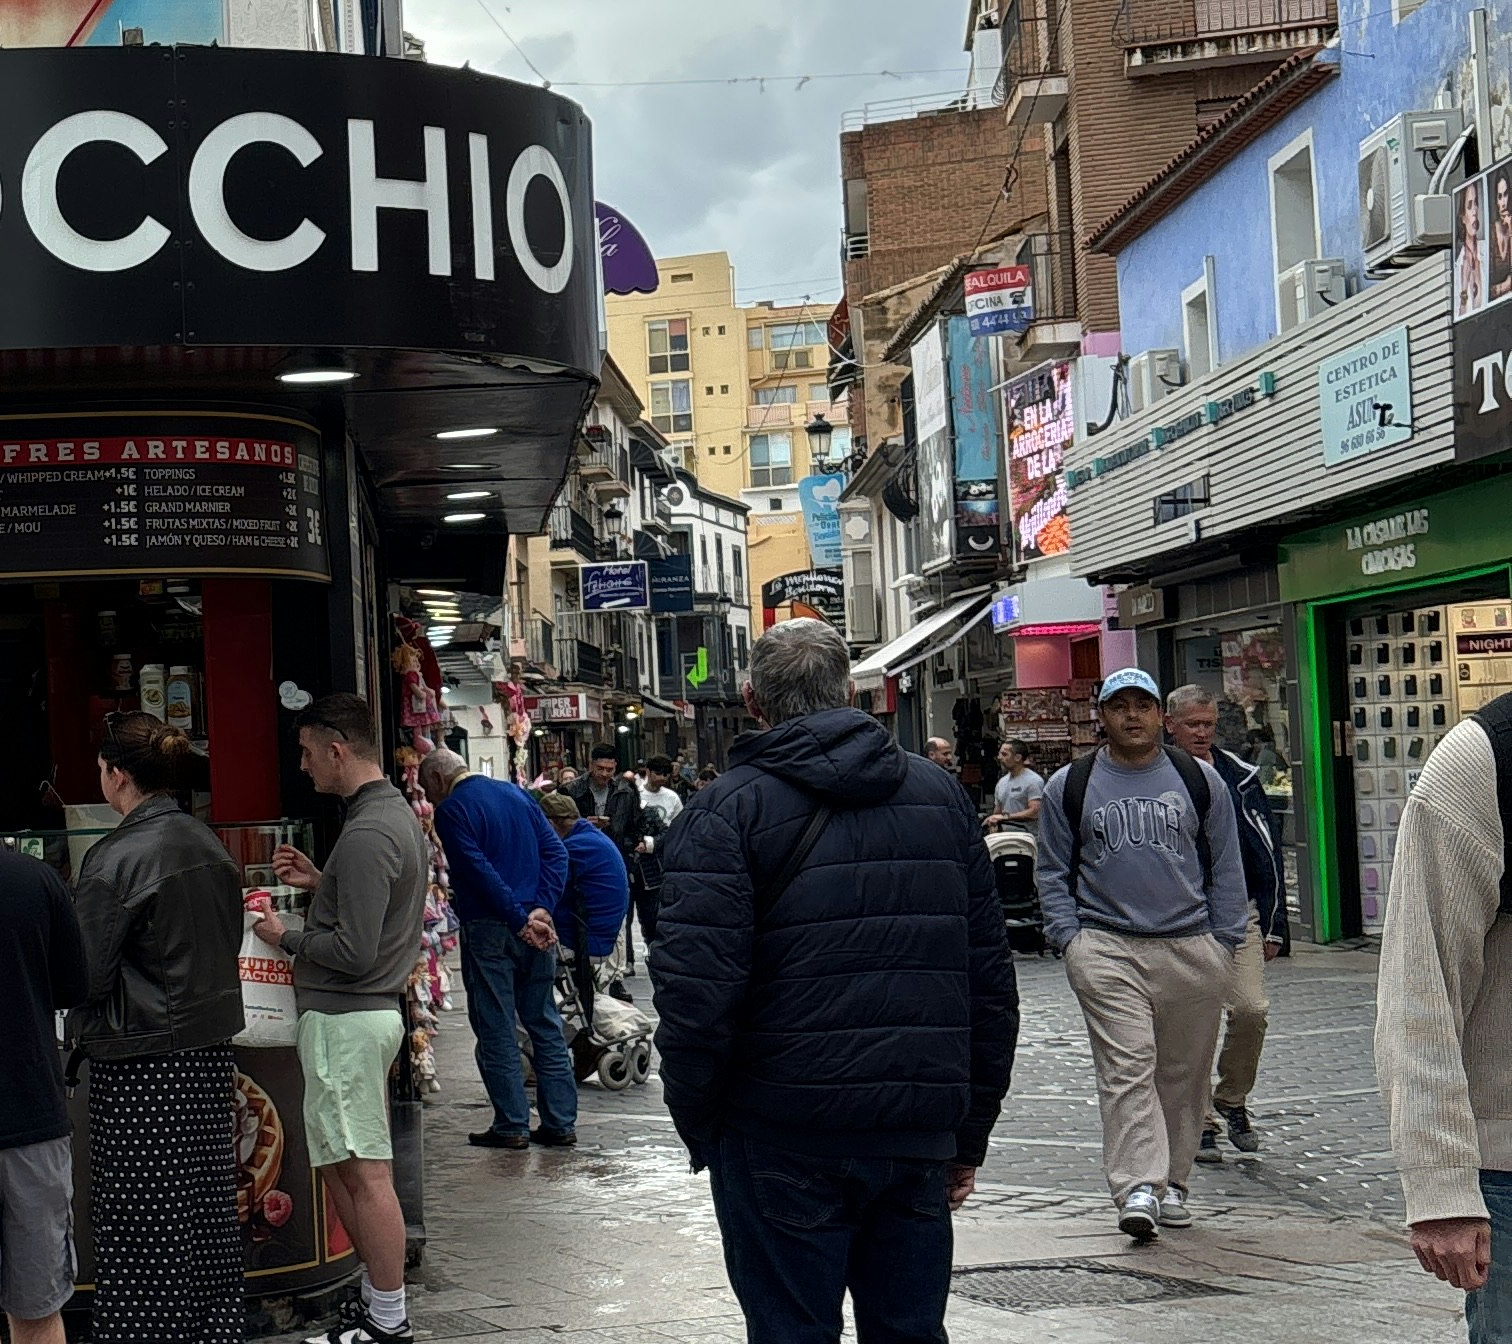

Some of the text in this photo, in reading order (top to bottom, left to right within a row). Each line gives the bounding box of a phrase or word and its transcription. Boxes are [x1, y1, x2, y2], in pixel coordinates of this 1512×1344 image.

[1326, 340, 1400, 385] CENTRO DE
[1334, 366, 1398, 404] ESTETICA
[120, 440, 294, 465] ARTESANOS
[8, 471, 62, 484] WHIPPED
[63, 469, 105, 482] CREAM
[143, 468, 196, 481] TOPPINGS
[115, 484, 138, 497] +1€
[144, 485, 189, 497] HELADO
[0, 504, 77, 517] MARMELADE
[144, 501, 184, 513] GRAND
[185, 501, 232, 513] MARNIER
[14, 521, 41, 533] MOU
[146, 518, 188, 531] FRUTAS
[189, 518, 226, 531] MIXTAS
[192, 534, 226, 546] QUESO
